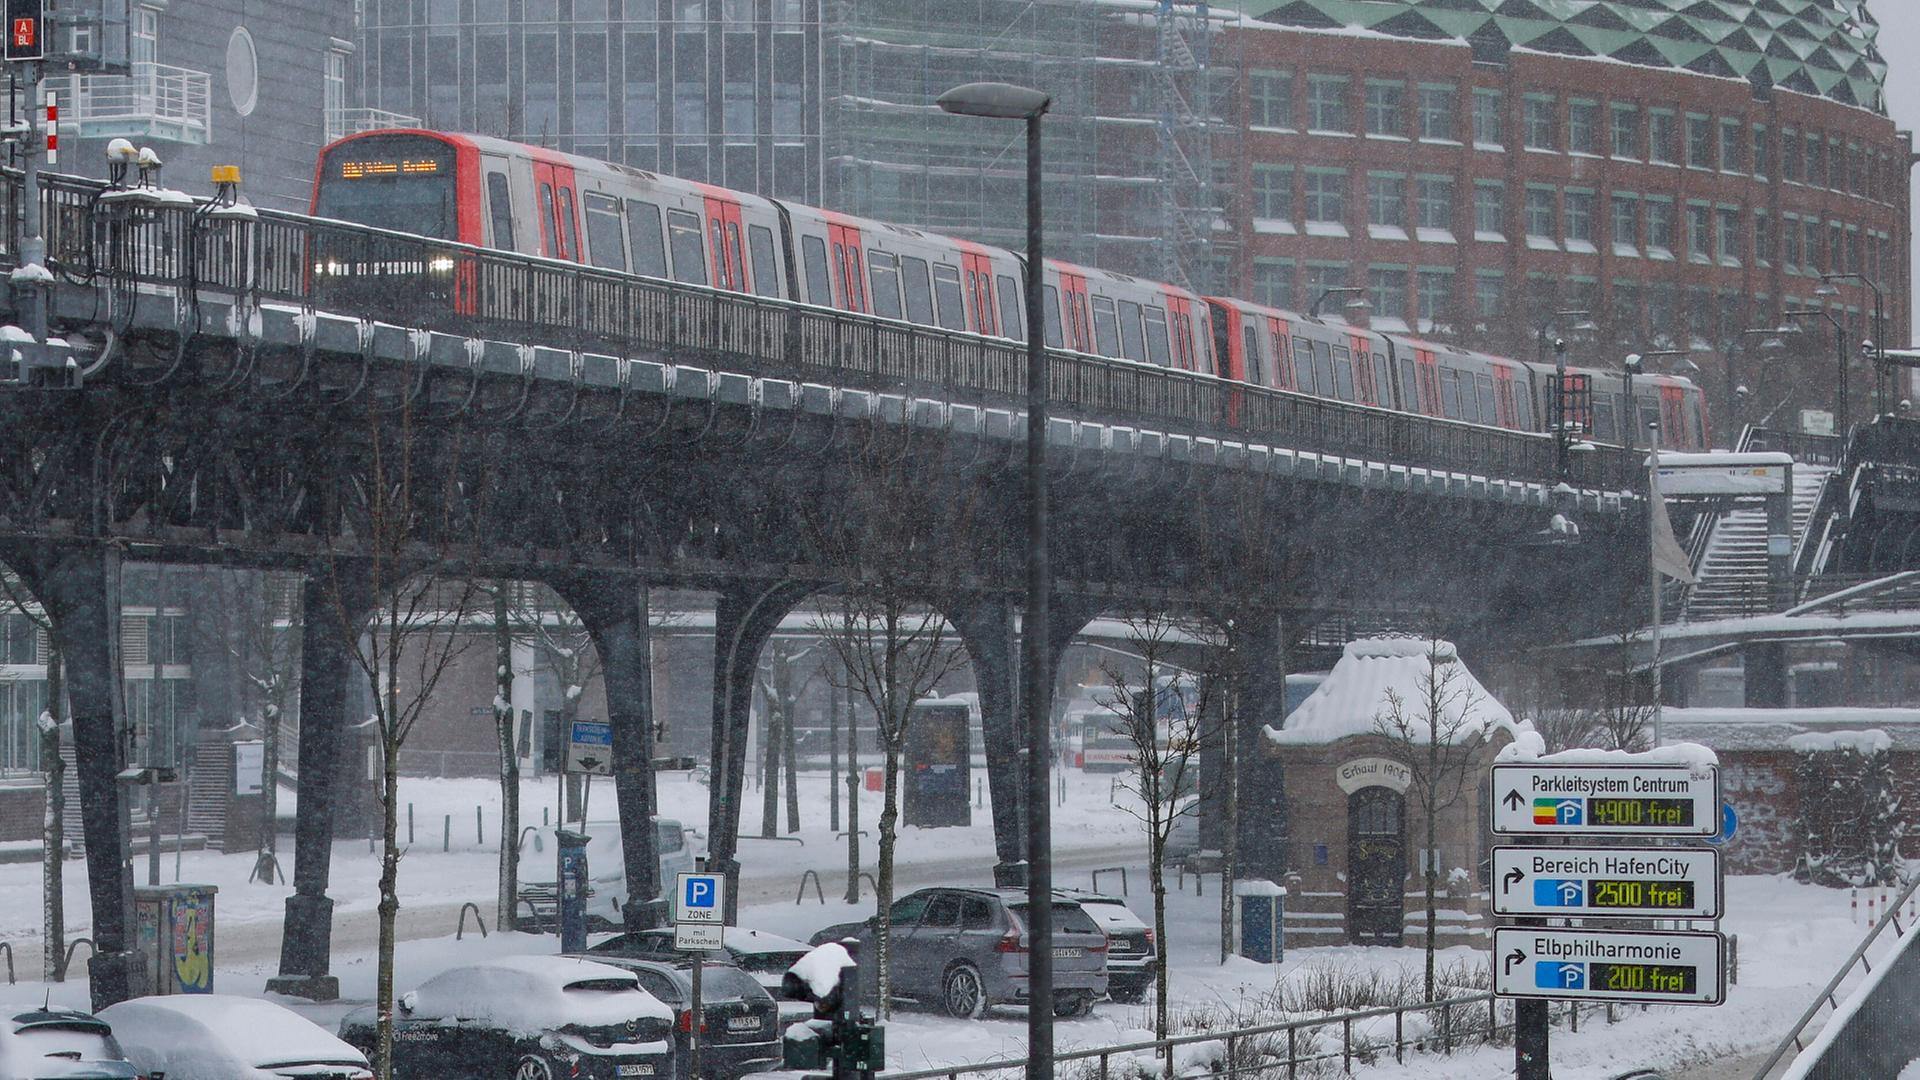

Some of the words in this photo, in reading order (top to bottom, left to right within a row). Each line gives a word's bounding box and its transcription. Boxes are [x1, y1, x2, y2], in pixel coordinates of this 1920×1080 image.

[20, 21, 28, 32] A
[18, 35, 29, 45] BL
[1532, 775, 1629, 796] Parkleitsystem
[1633, 775, 1689, 793] Centrum
[1564, 806, 1576, 824] P
[1594, 800, 1642, 824] 4900
[1647, 801, 1681, 824] frei
[1533, 856, 1599, 873] Bereich
[1605, 857, 1690, 879] HafenCity
[692, 881, 708, 904] P
[1564, 887, 1577, 905] P
[1595, 881, 1642, 906] 2500
[1648, 883, 1682, 906] frei
[687, 910, 712, 919] ZONE
[678, 936, 720, 945] Parkschein
[1535, 938, 1681, 960] Elbphilharmonie
[1565, 970, 1578, 988] P
[1608, 965, 1644, 990] 200
[1650, 967, 1684, 991] frei
